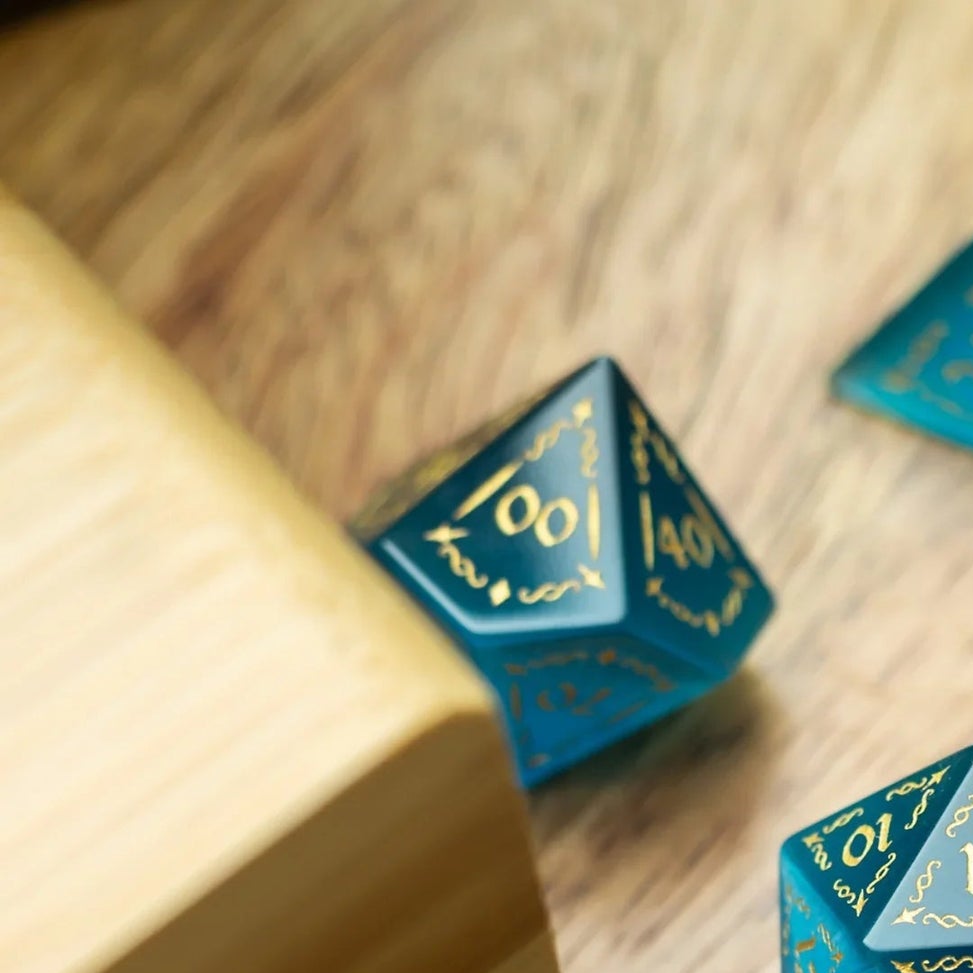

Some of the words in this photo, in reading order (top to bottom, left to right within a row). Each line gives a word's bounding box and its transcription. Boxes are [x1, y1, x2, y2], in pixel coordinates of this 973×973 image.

[495, 484, 579, 547] 00
[657, 514, 715, 569] 40
[842, 813, 893, 868] 10
